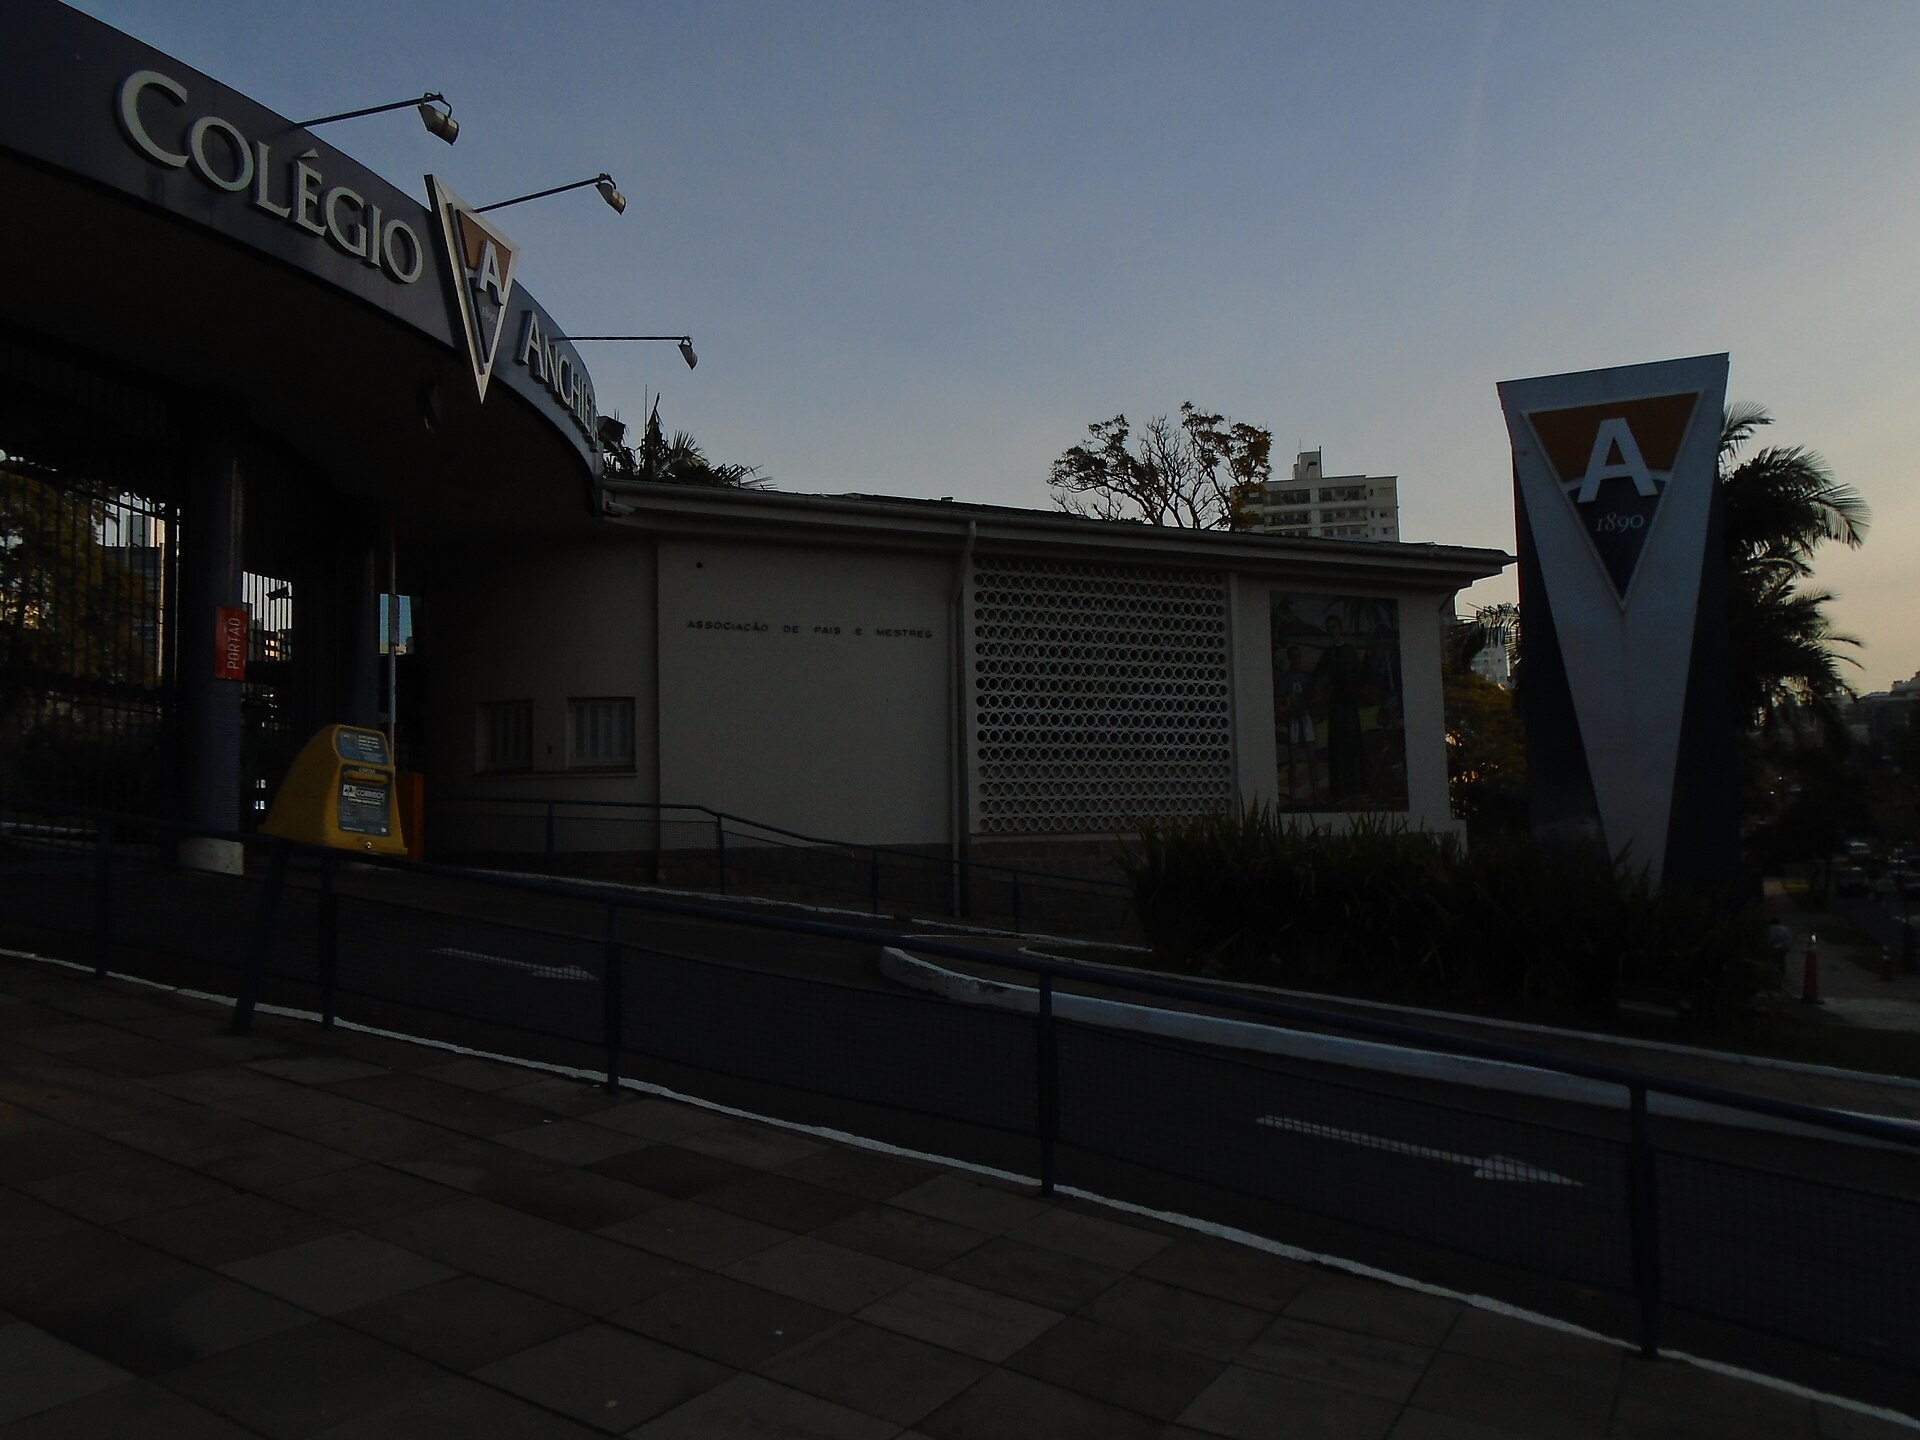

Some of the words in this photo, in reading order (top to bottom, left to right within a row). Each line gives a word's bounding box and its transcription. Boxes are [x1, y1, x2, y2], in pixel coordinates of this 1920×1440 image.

[117, 69, 424, 285] COLÉGIO
[518, 310, 599, 452] ANCHIE
[1577, 417, 1659, 504] A
[1595, 512, 1645, 534] 1890
[223, 617, 241, 670] PORTÃO
[783, 625, 799, 634] DE
[814, 626, 841, 635] PAIS
[854, 628, 863, 636] E
[876, 628, 933, 639] MESTRES
